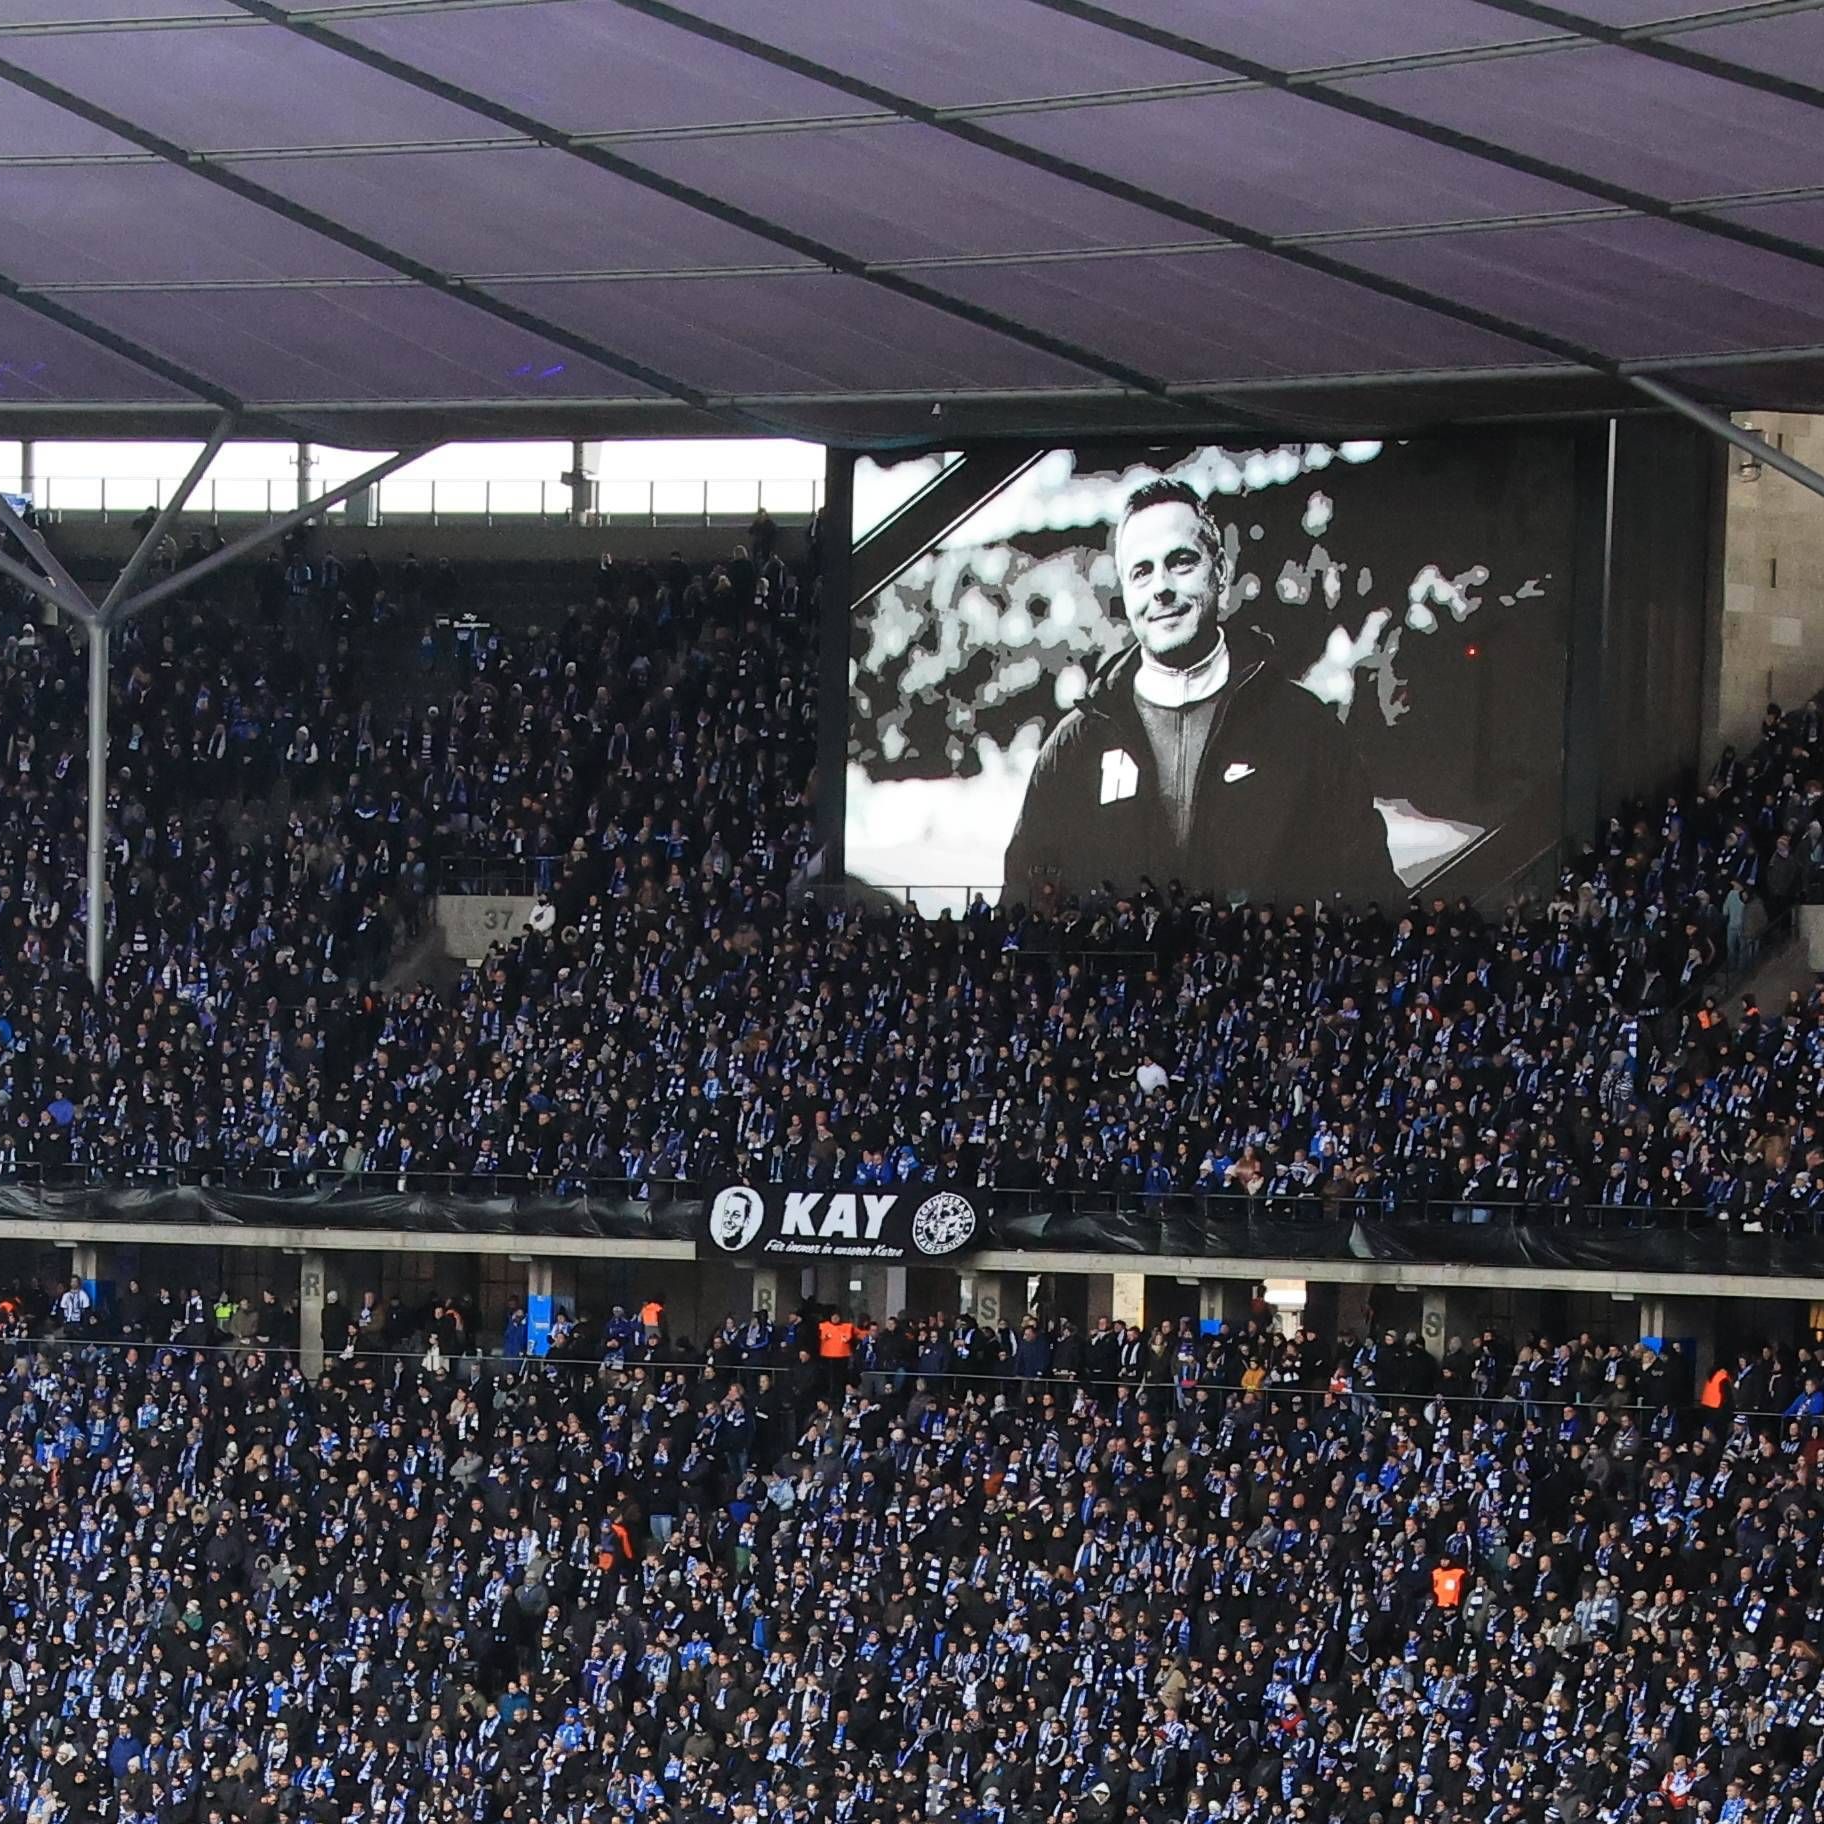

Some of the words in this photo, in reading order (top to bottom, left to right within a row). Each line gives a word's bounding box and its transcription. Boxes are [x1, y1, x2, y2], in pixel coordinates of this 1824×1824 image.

[484, 910, 513, 931] 37
[780, 1192, 899, 1239] KAY
[821, 1243, 833, 1255] in
[303, 1273, 321, 1298] R
[980, 1296, 998, 1320] S
[1423, 1311, 1444, 1338] S
